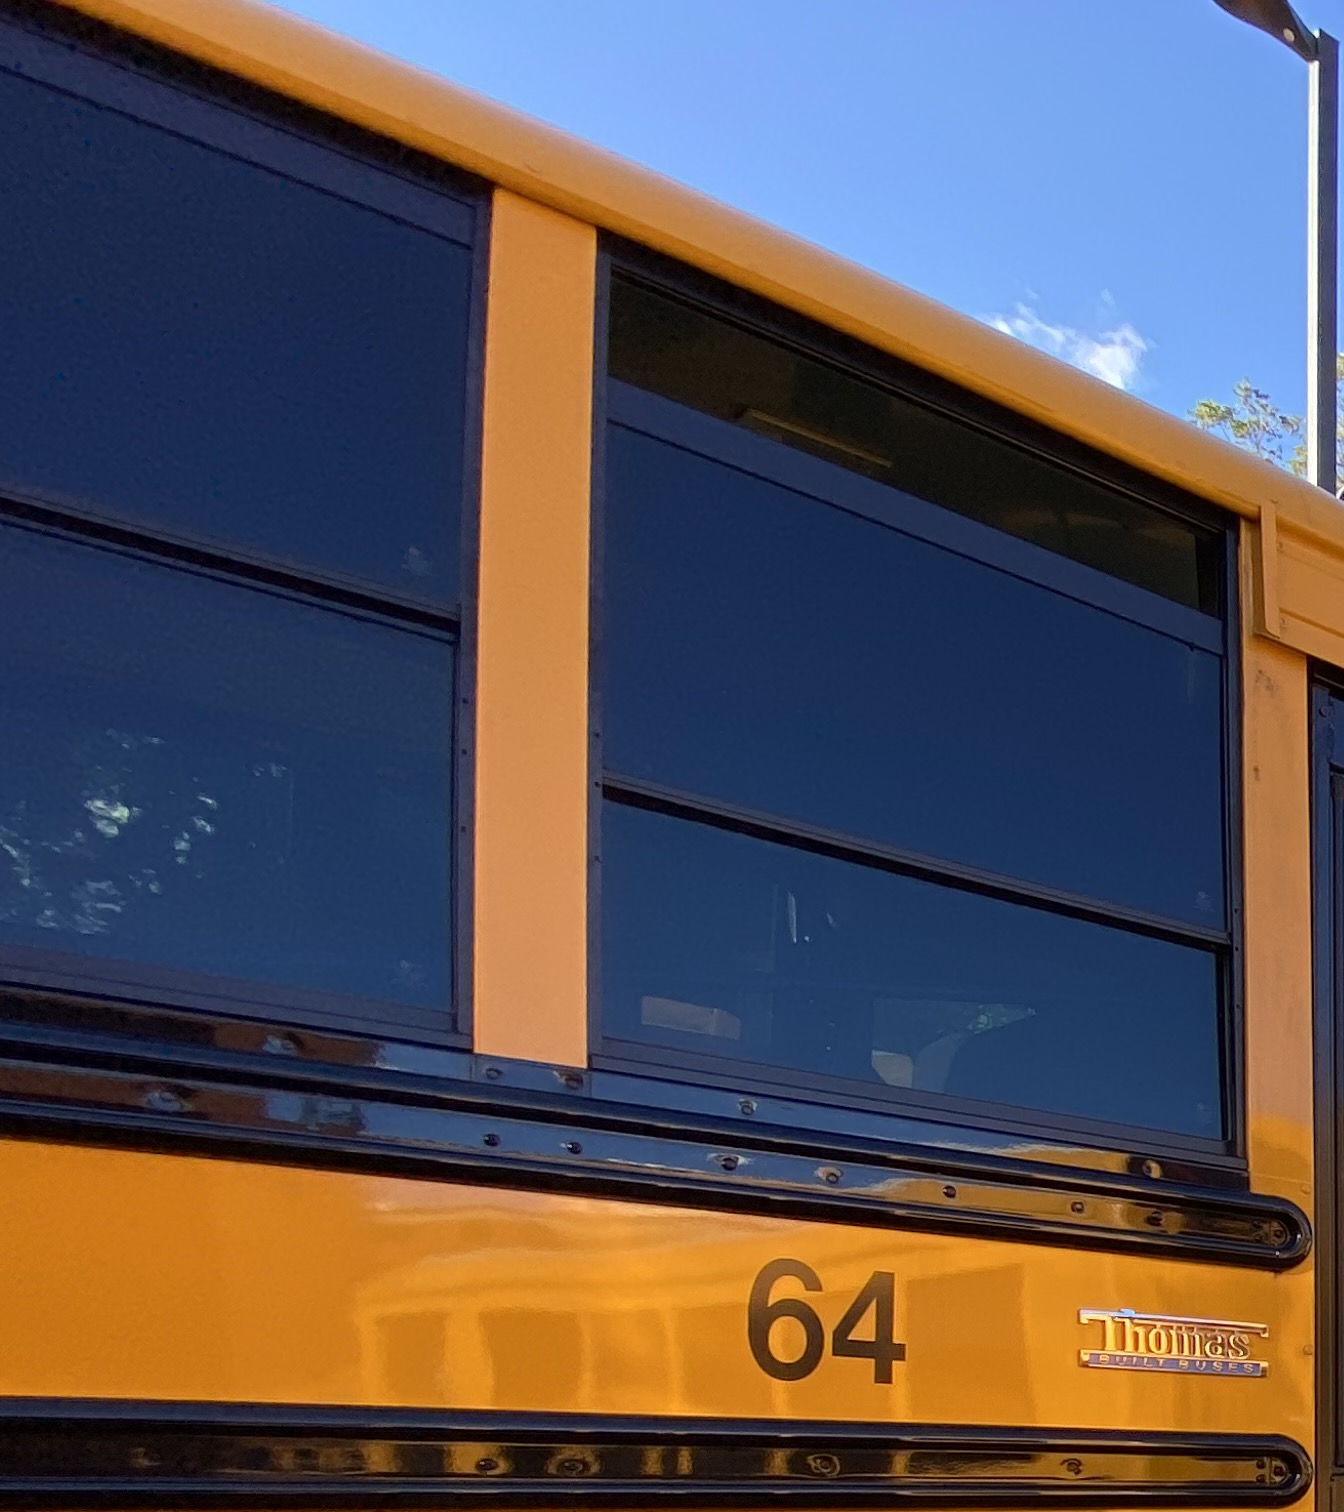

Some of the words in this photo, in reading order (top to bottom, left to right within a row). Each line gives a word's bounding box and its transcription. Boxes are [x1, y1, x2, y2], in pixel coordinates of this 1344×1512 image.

[748, 1257, 906, 1384] 64
[1087, 1316, 1250, 1360] Thomas
[1099, 1354, 1165, 1368] BUILT
[1179, 1358, 1255, 1374] BUSES
